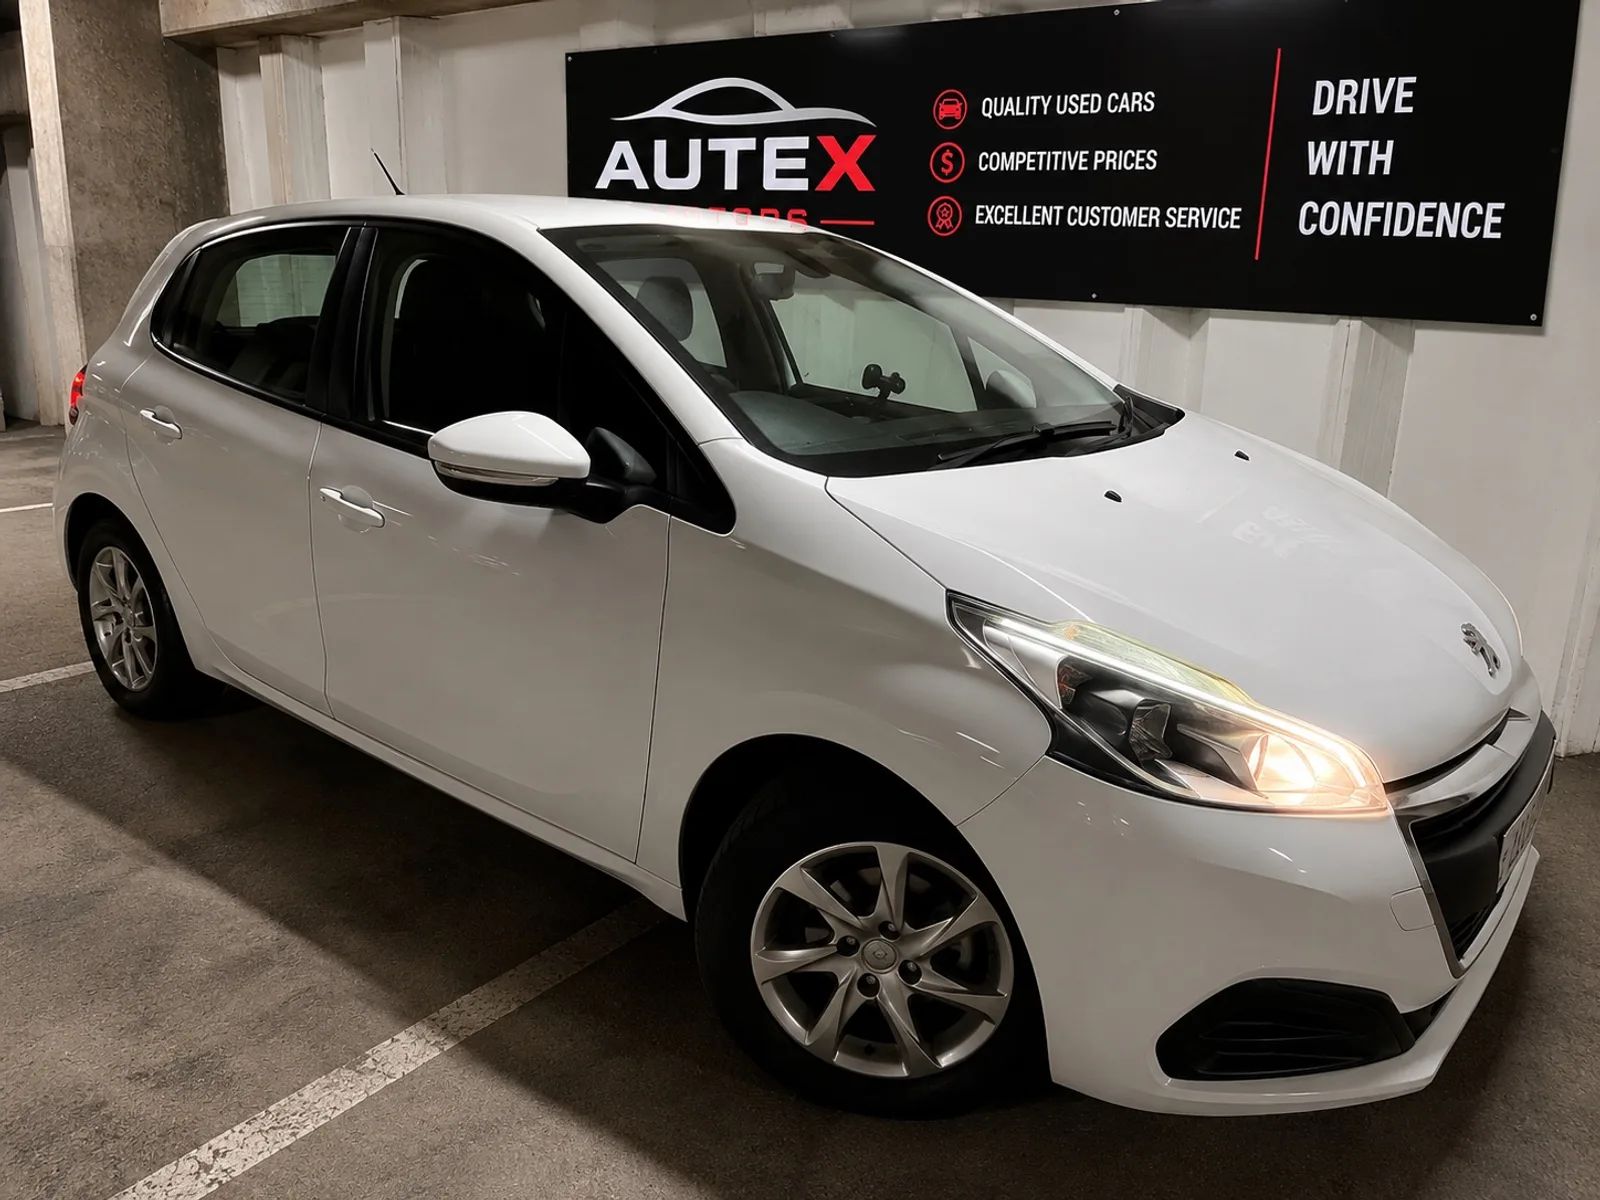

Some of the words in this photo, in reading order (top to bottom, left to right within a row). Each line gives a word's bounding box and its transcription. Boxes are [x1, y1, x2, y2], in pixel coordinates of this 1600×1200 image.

[981, 94, 1052, 119] QUALITY
[1056, 93, 1102, 115] USED
[1107, 91, 1156, 114] CARS
[1312, 76, 1417, 116] DRIVE
[594, 134, 877, 192] AUTEX
[978, 151, 1089, 172] COMPETITIVE
[1093, 149, 1158, 171] PRICES
[1307, 139, 1395, 176] WITH
[975, 204, 1063, 226] EXCELLENT
[1067, 205, 1161, 228] CUSTOMER
[1164, 206, 1243, 230] SERVICE
[1298, 200, 1506, 239] CONFIDENCE
